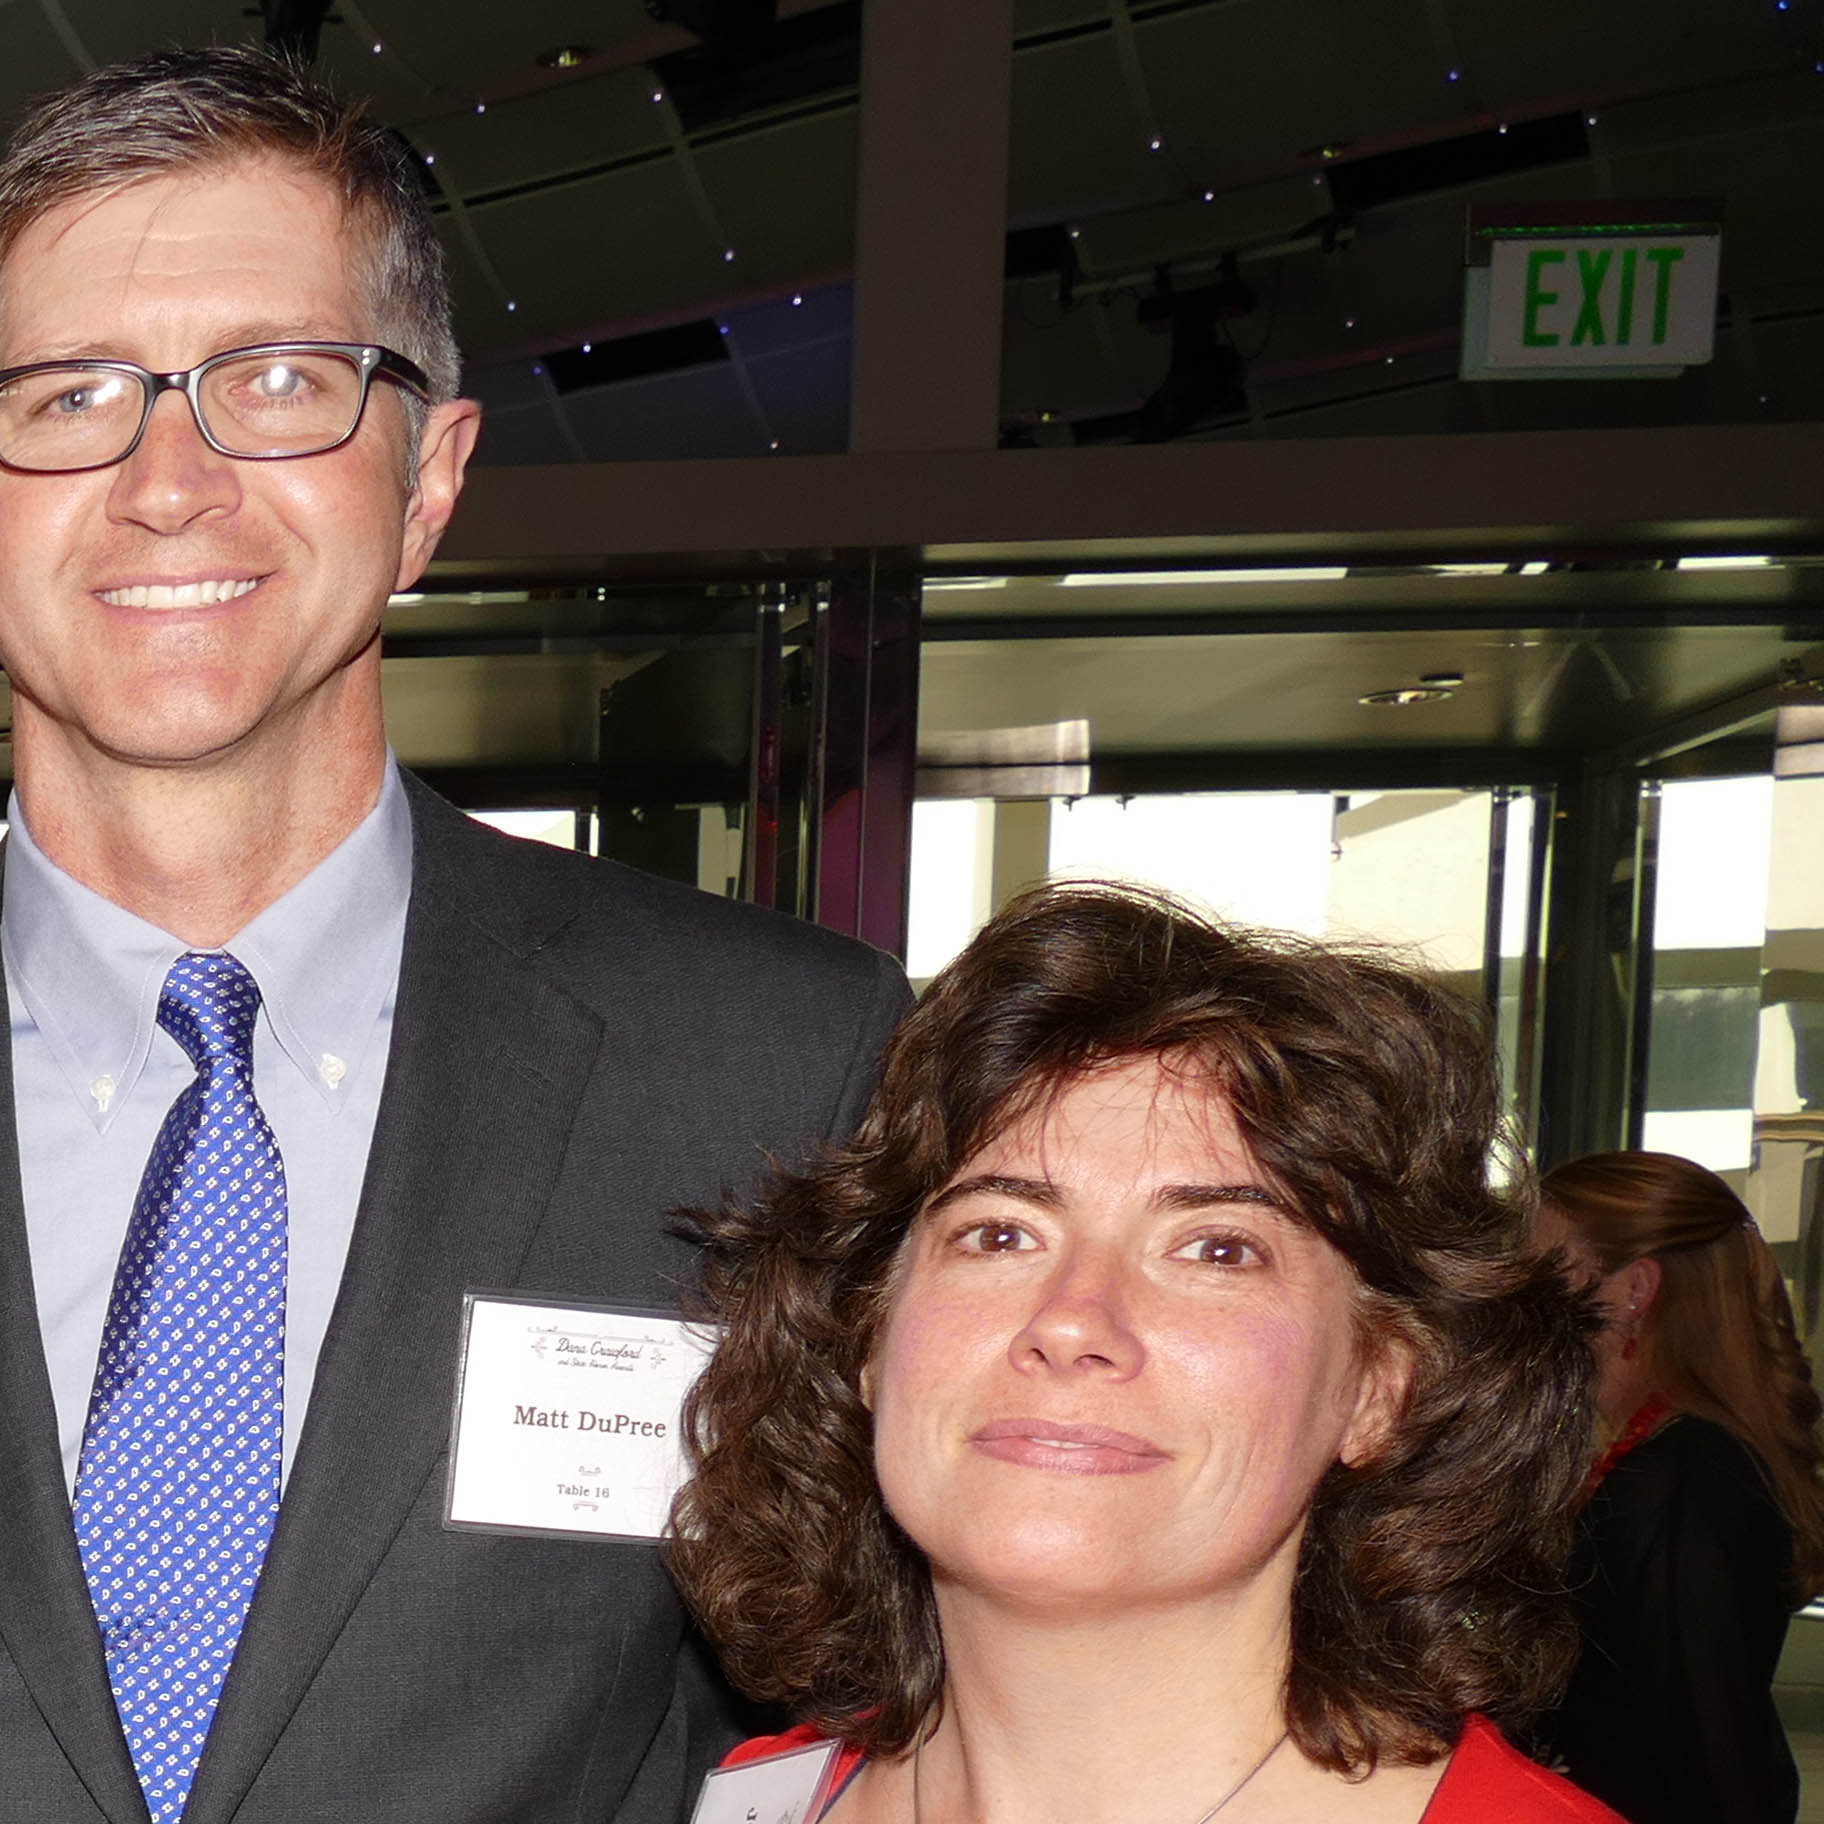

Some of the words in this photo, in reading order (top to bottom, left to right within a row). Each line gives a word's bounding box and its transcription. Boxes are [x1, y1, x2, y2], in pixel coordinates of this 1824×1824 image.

[1522, 249, 1684, 346] EXIT
[513, 1405, 569, 1430] Matt
[577, 1411, 667, 1438] DuPree
[557, 1483, 590, 1497] Table
[595, 1487, 610, 1499] 16
